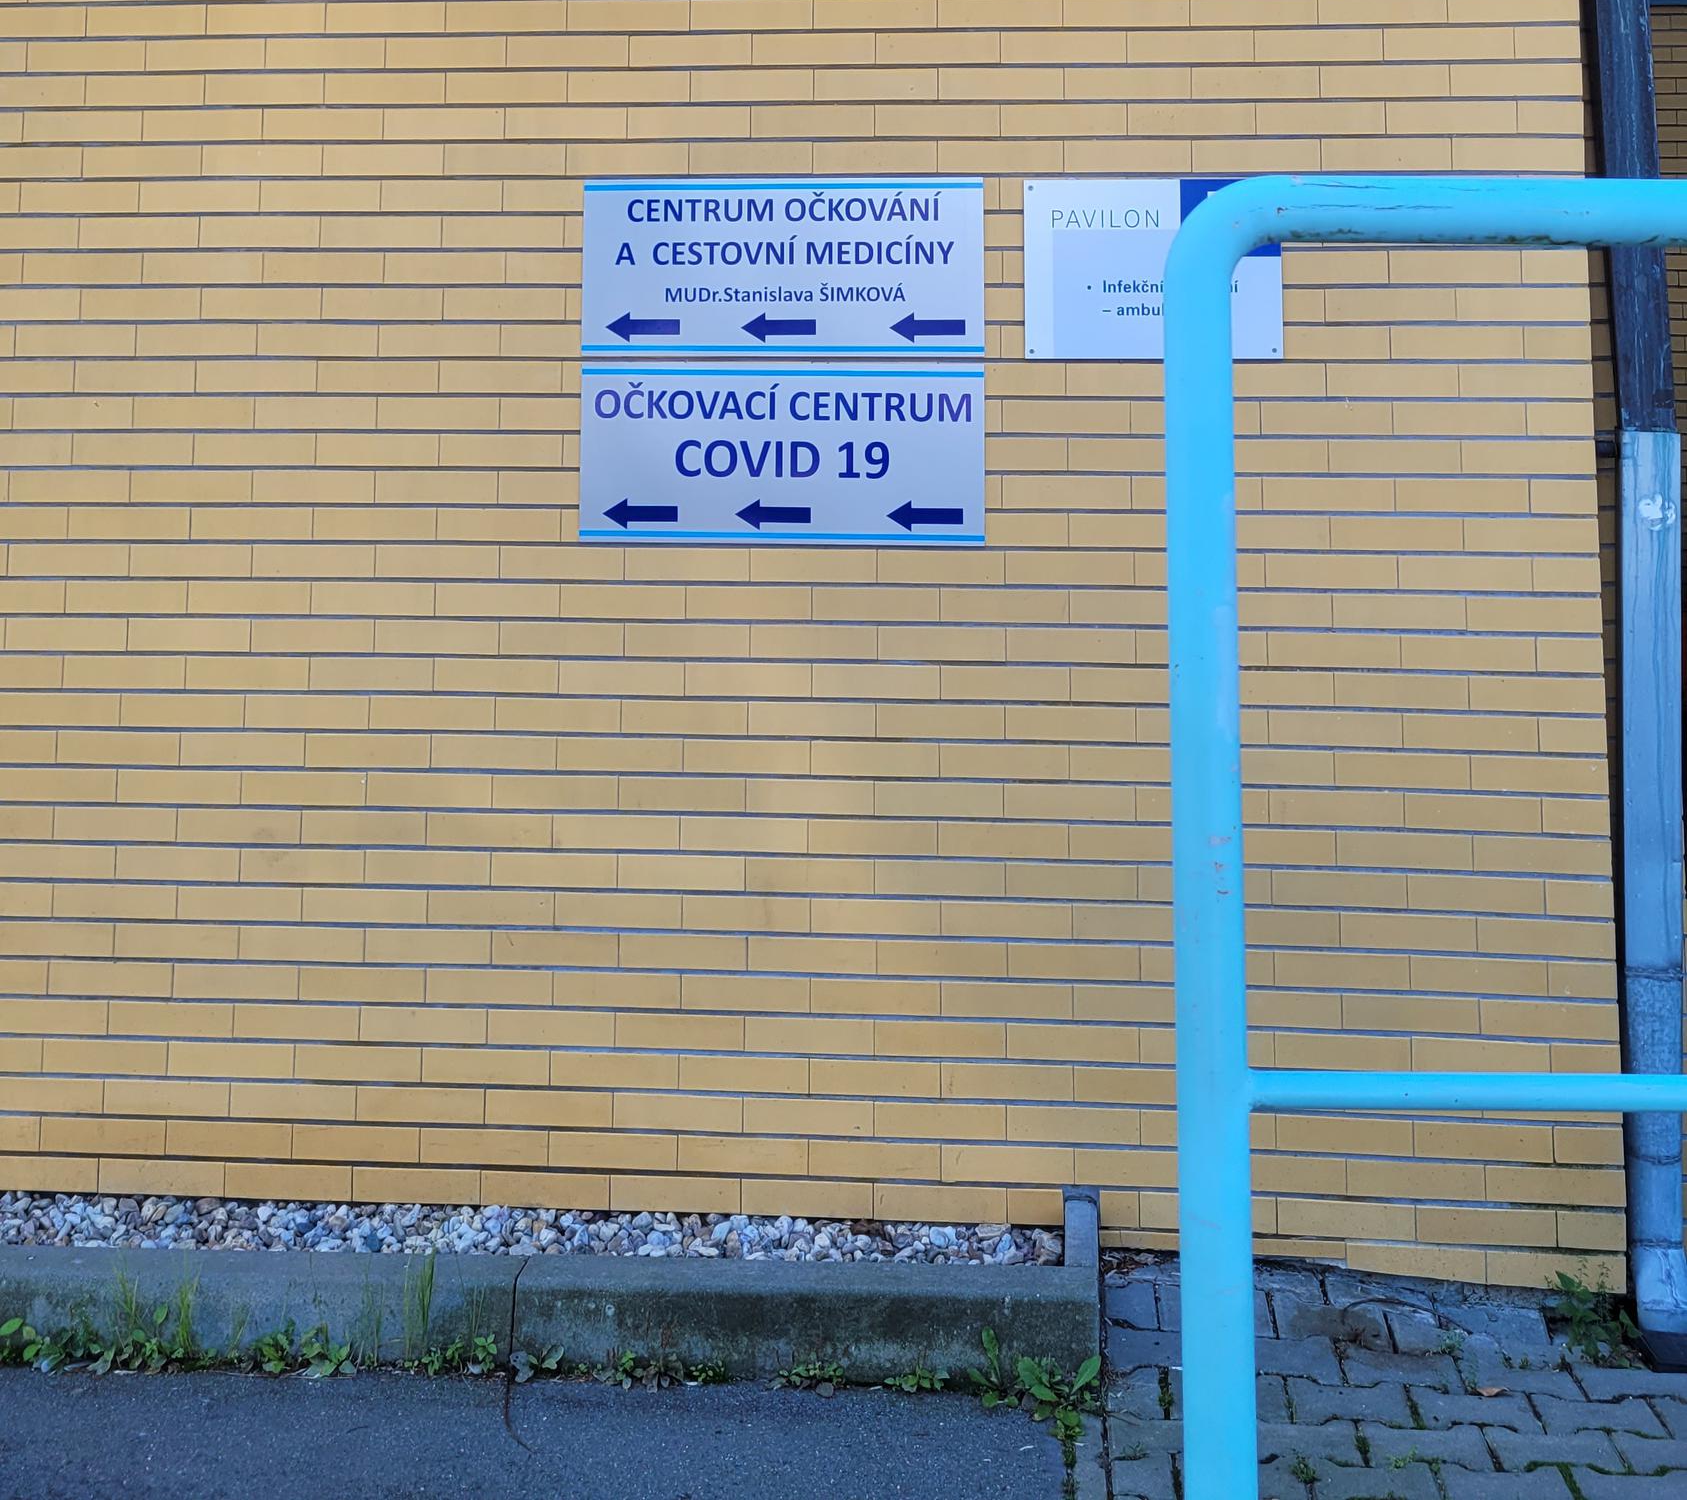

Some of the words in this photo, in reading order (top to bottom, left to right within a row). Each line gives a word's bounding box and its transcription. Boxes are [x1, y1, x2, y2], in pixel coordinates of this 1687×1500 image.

[627, 198, 774, 223] CENTRUM
[784, 191, 942, 222] OČKOVÁNÍ
[1051, 209, 1160, 229] PAVILON
[614, 242, 636, 266] A
[652, 234, 798, 266] CESTOVNÍ
[806, 234, 955, 265] MEDICÍNY
[665, 285, 814, 303] MUDr.Stanislava
[819, 282, 906, 302] ŠIMKOVÁ
[1102, 279, 1164, 294] Infekční
[1116, 301, 1164, 317] ambul
[594, 381, 780, 421] OČKOVACÍ
[789, 391, 972, 423] CENTRUM
[675, 439, 821, 478] COVID
[837, 441, 890, 480] 19
